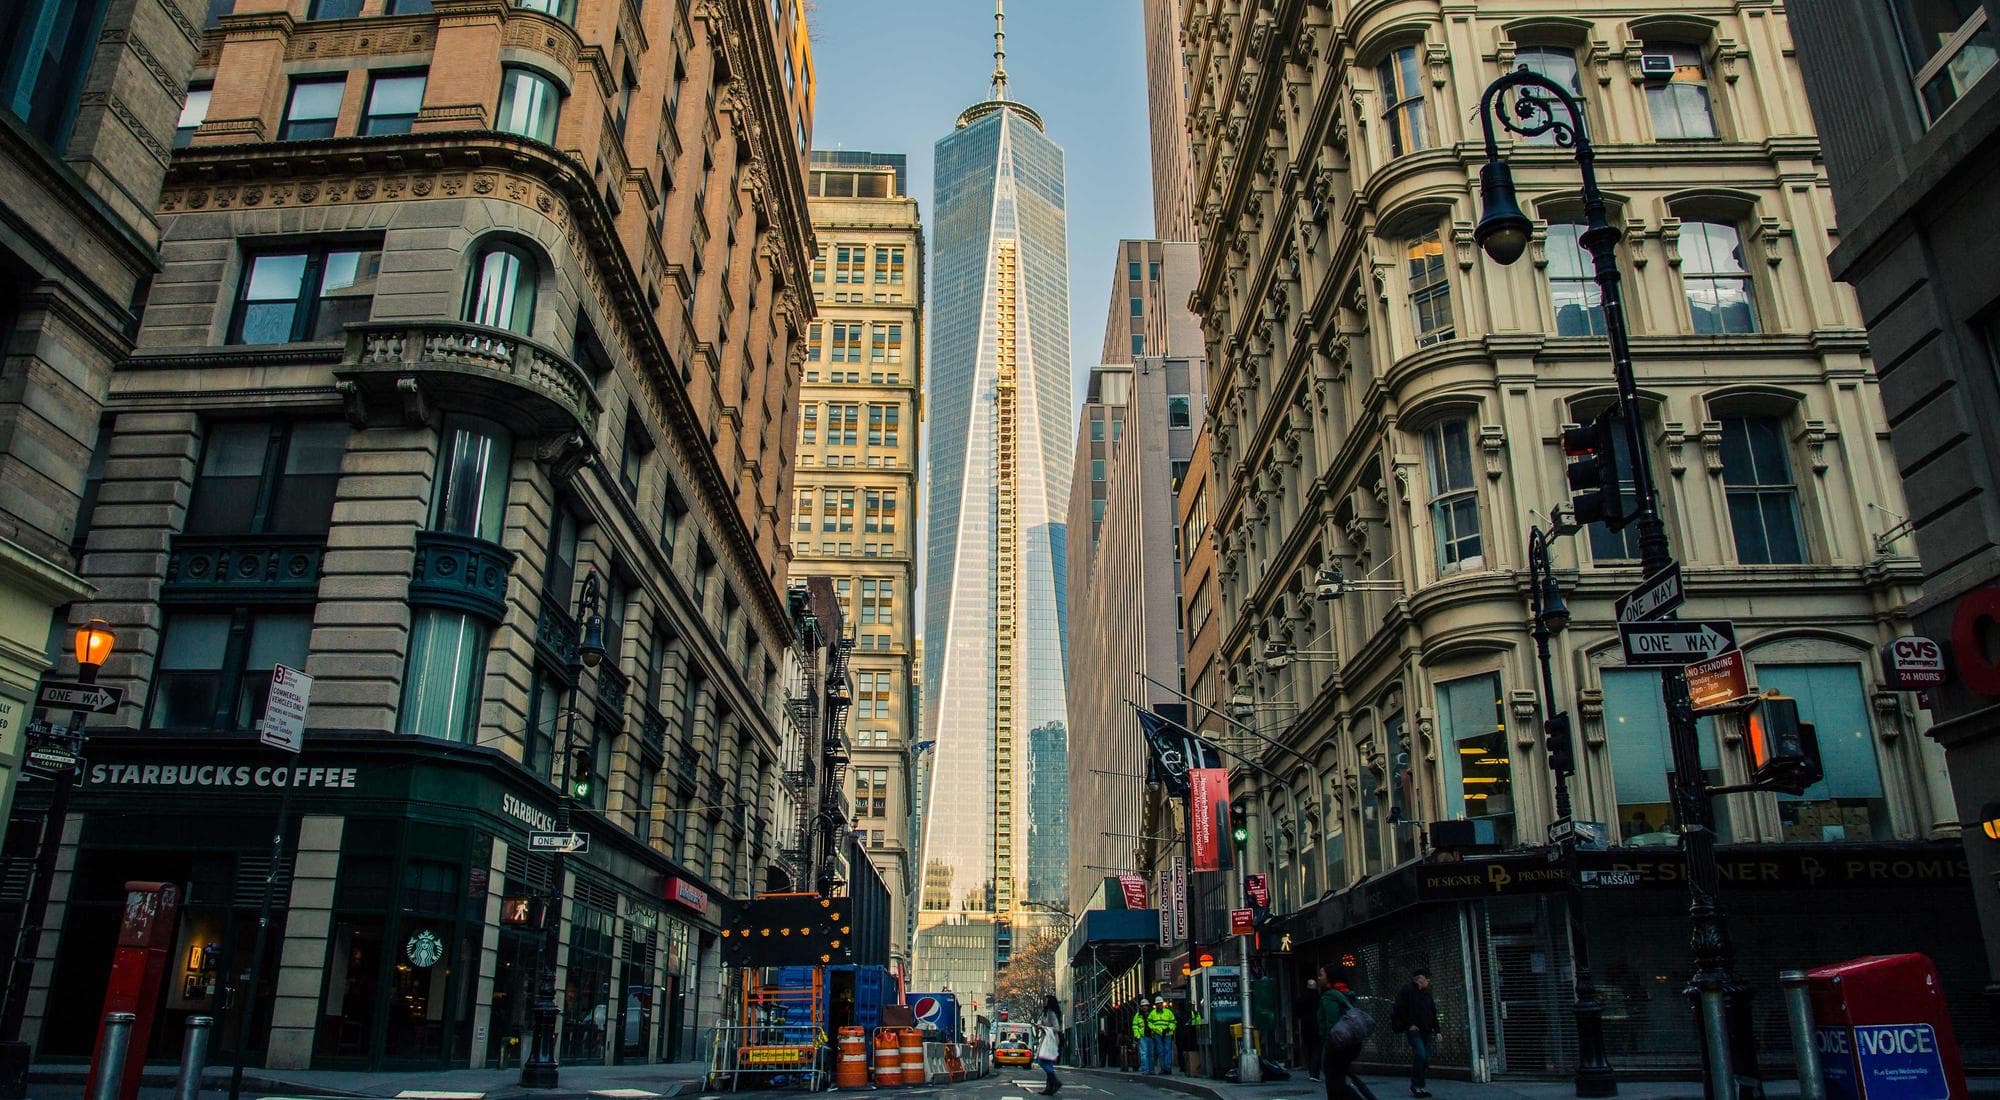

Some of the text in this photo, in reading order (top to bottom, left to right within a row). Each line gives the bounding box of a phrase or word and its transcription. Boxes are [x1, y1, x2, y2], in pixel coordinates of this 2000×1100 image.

[1626, 582, 1672, 621] ONE WAY
[1639, 634, 1717, 652] ONE WAY
[1895, 641, 1938, 659] CVS
[1688, 656, 1733, 677] NO STANDING
[1899, 659, 1938, 668] pharmacy
[275, 666, 283, 682] 3
[1690, 675, 1711, 686] Monday
[1901, 672, 1940, 681] 24 HOURS
[48, 690, 108, 704] ONE WAY
[273, 687, 302, 703] COMMERCIAL
[272, 696, 305, 712] VEHICLES ONLY
[41, 760, 63, 768] COFFEE
[91, 764, 358, 788] STARBUCKS COFFEE
[503, 793, 551, 832] STARBUCKS
[537, 837, 555, 846] ONE
[1427, 874, 1481, 889] DESIGNER
[1600, 874, 1635, 886] NASSAU
[1815, 1030, 1849, 1054] OICE
[1863, 1028, 1933, 1055] VOICE
